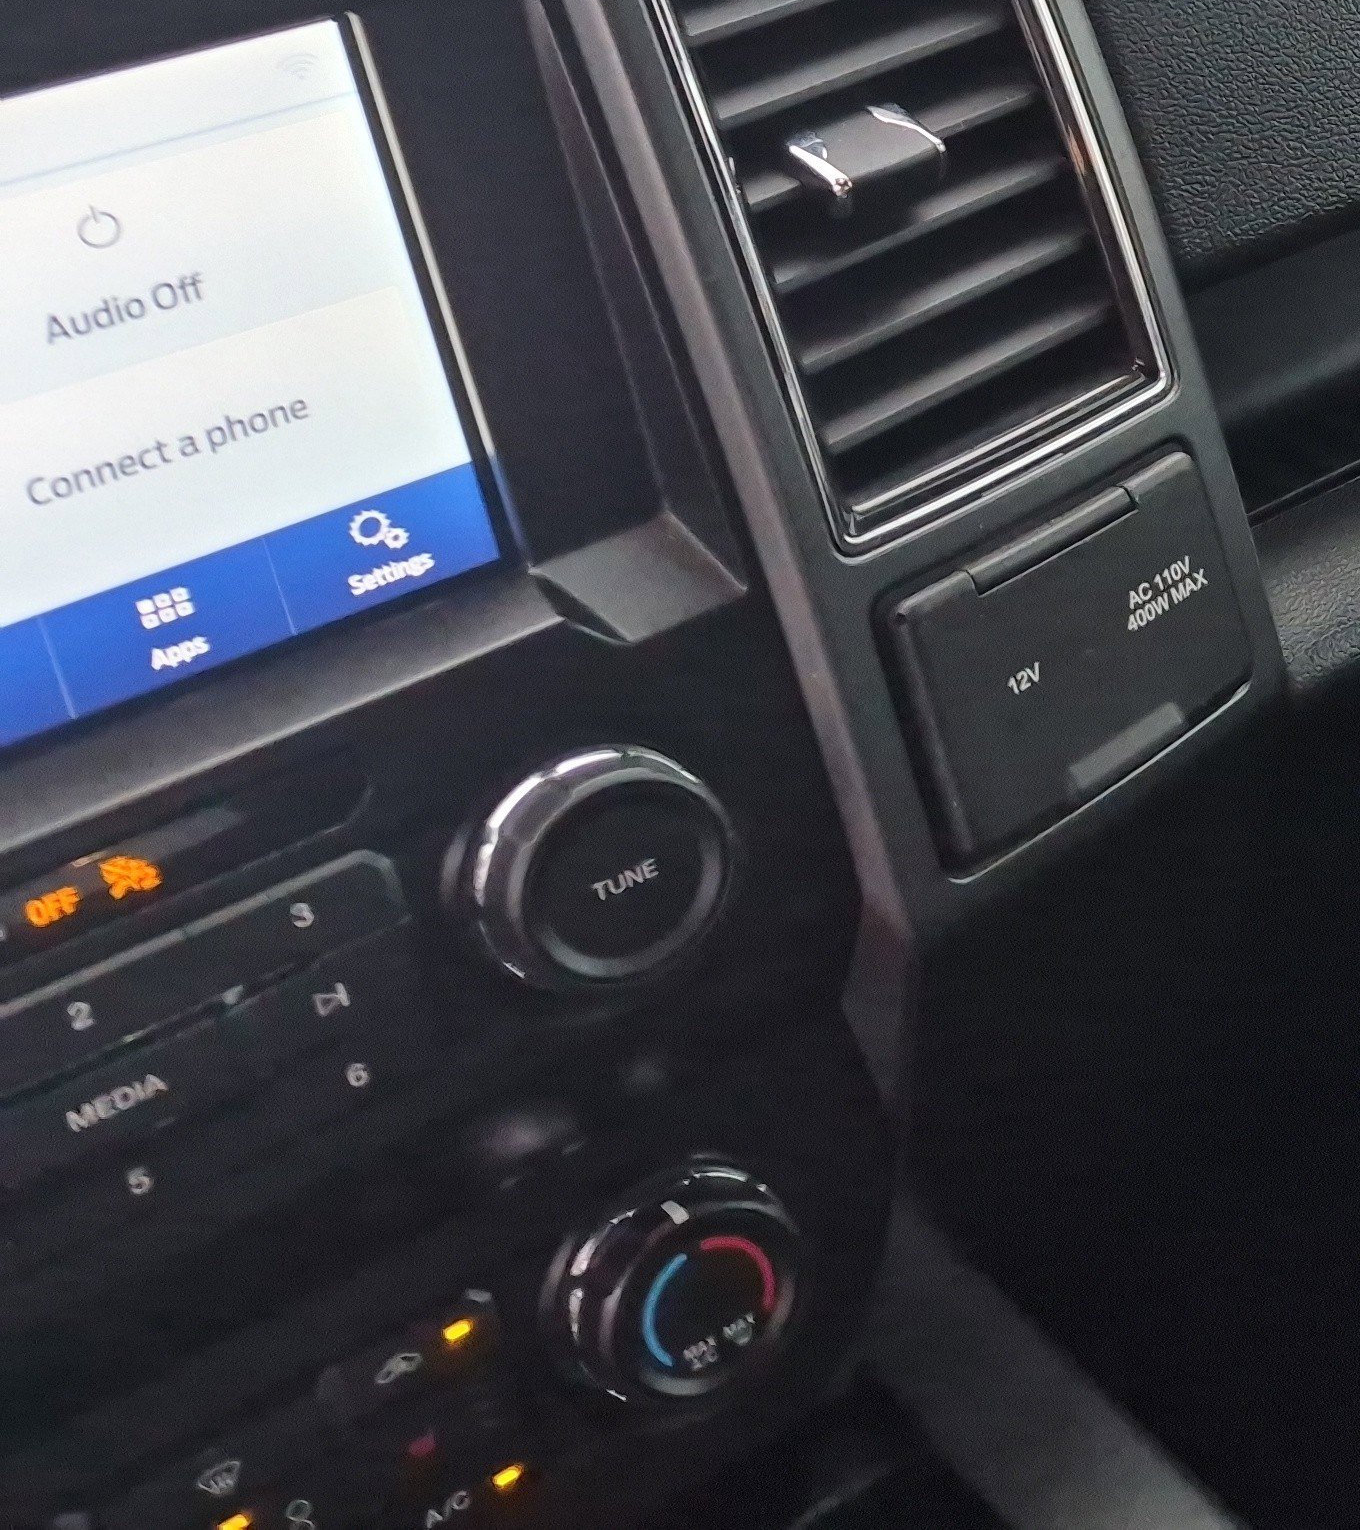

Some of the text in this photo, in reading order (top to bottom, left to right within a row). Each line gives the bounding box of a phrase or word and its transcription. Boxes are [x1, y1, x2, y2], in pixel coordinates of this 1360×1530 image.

[47, 271, 204, 345] Audio Off
[26, 398, 310, 506] Connect a phone
[347, 553, 435, 596] Settings
[1128, 555, 1190, 610] AC 110V
[1127, 568, 1208, 631] 400W MAX
[151, 636, 210, 671] Apps
[1007, 661, 1040, 695] 12V
[592, 858, 659, 901] TUNE
[25, 886, 81, 927] OFF
[289, 902, 315, 928] 3
[67, 1001, 95, 1031] 2
[347, 1063, 370, 1087] 6
[65, 1073, 168, 1133] MEDIA
[425, 1490, 471, 1529] A/C
